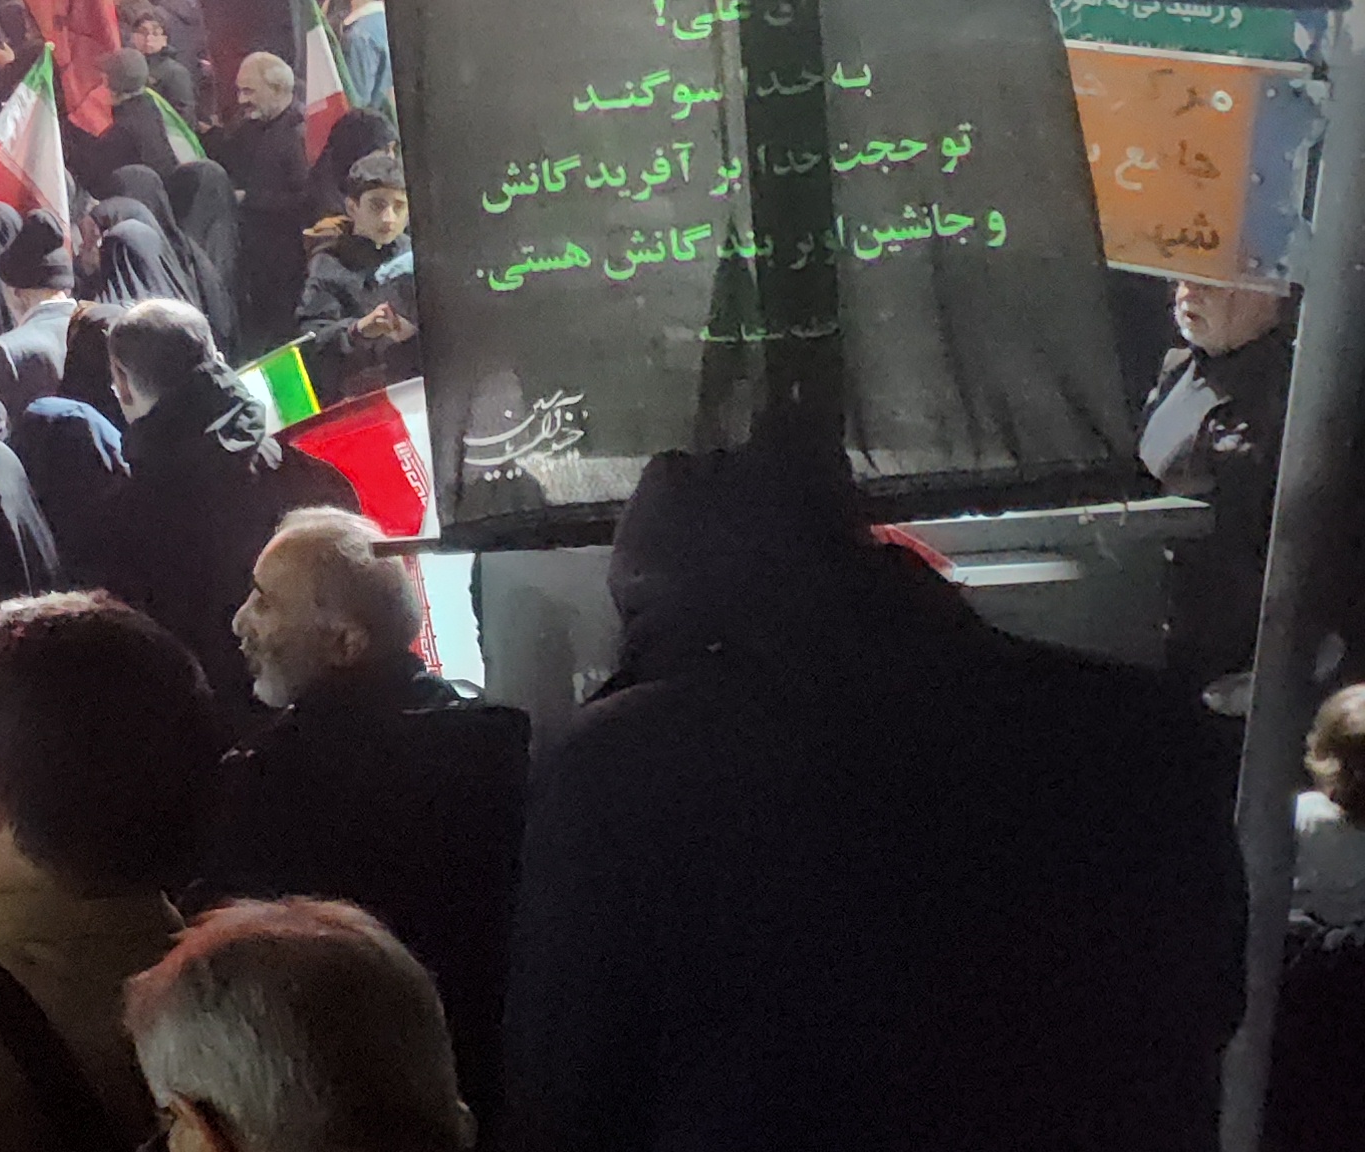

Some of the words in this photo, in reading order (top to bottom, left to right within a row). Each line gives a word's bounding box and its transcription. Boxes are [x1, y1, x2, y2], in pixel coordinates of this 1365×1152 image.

[831, 61, 873, 98] به
[830, 134, 928, 174] حجت
[939, 121, 974, 174] تو
[709, 152, 743, 196] بر
[853, 201, 976, 260] جانشین
[986, 208, 1008, 248] و
